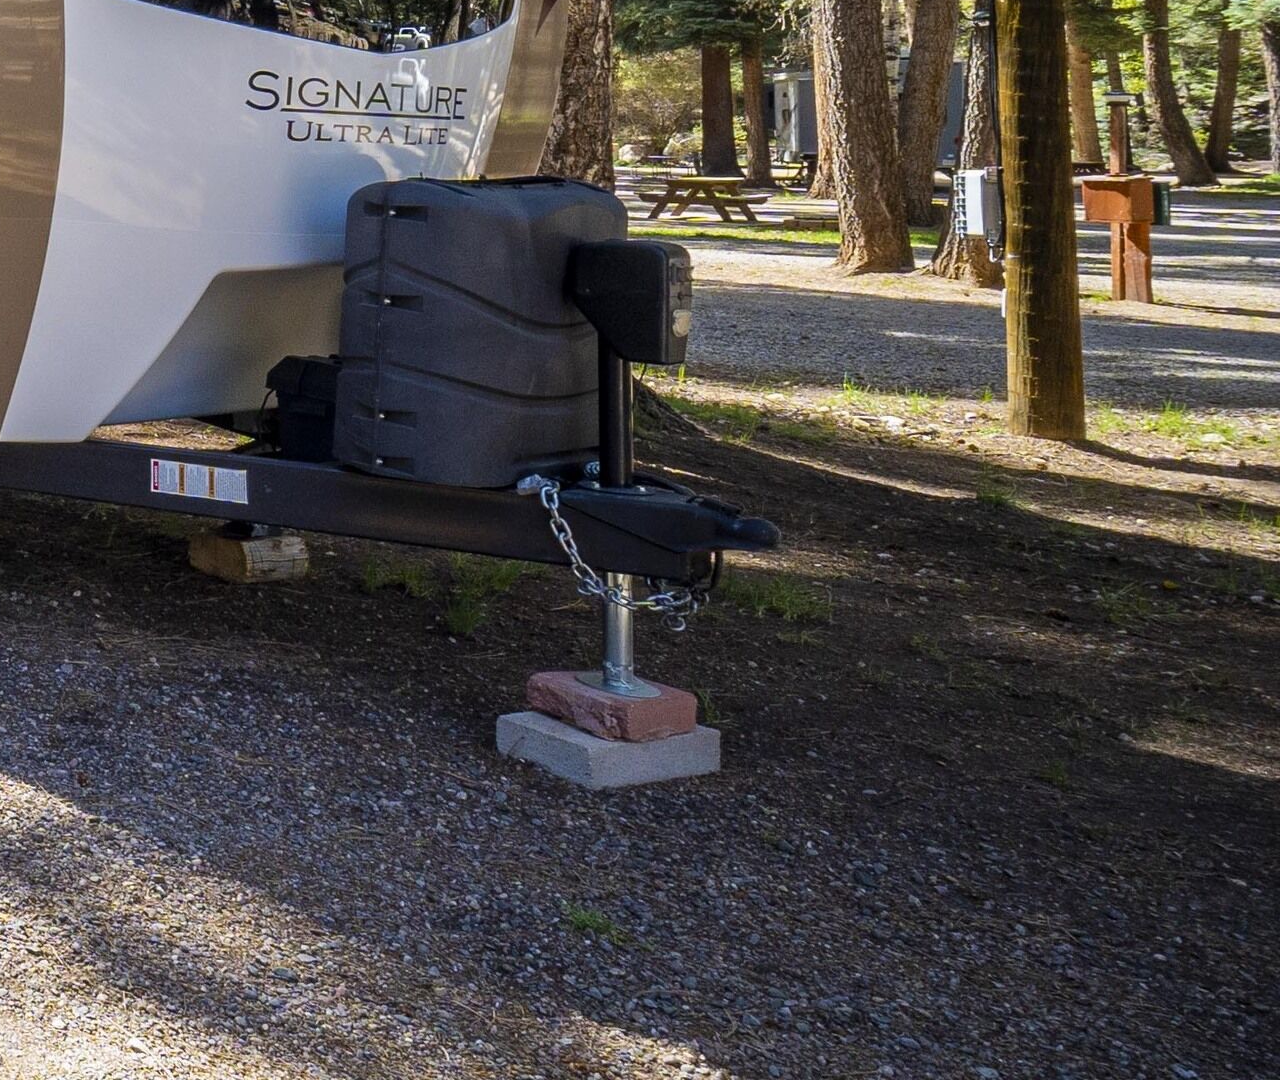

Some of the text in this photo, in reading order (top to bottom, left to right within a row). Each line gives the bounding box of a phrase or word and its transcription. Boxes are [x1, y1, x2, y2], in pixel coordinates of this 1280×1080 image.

[245, 70, 468, 120] SIGNATURE
[286, 120, 449, 146] ULTRA LITE
